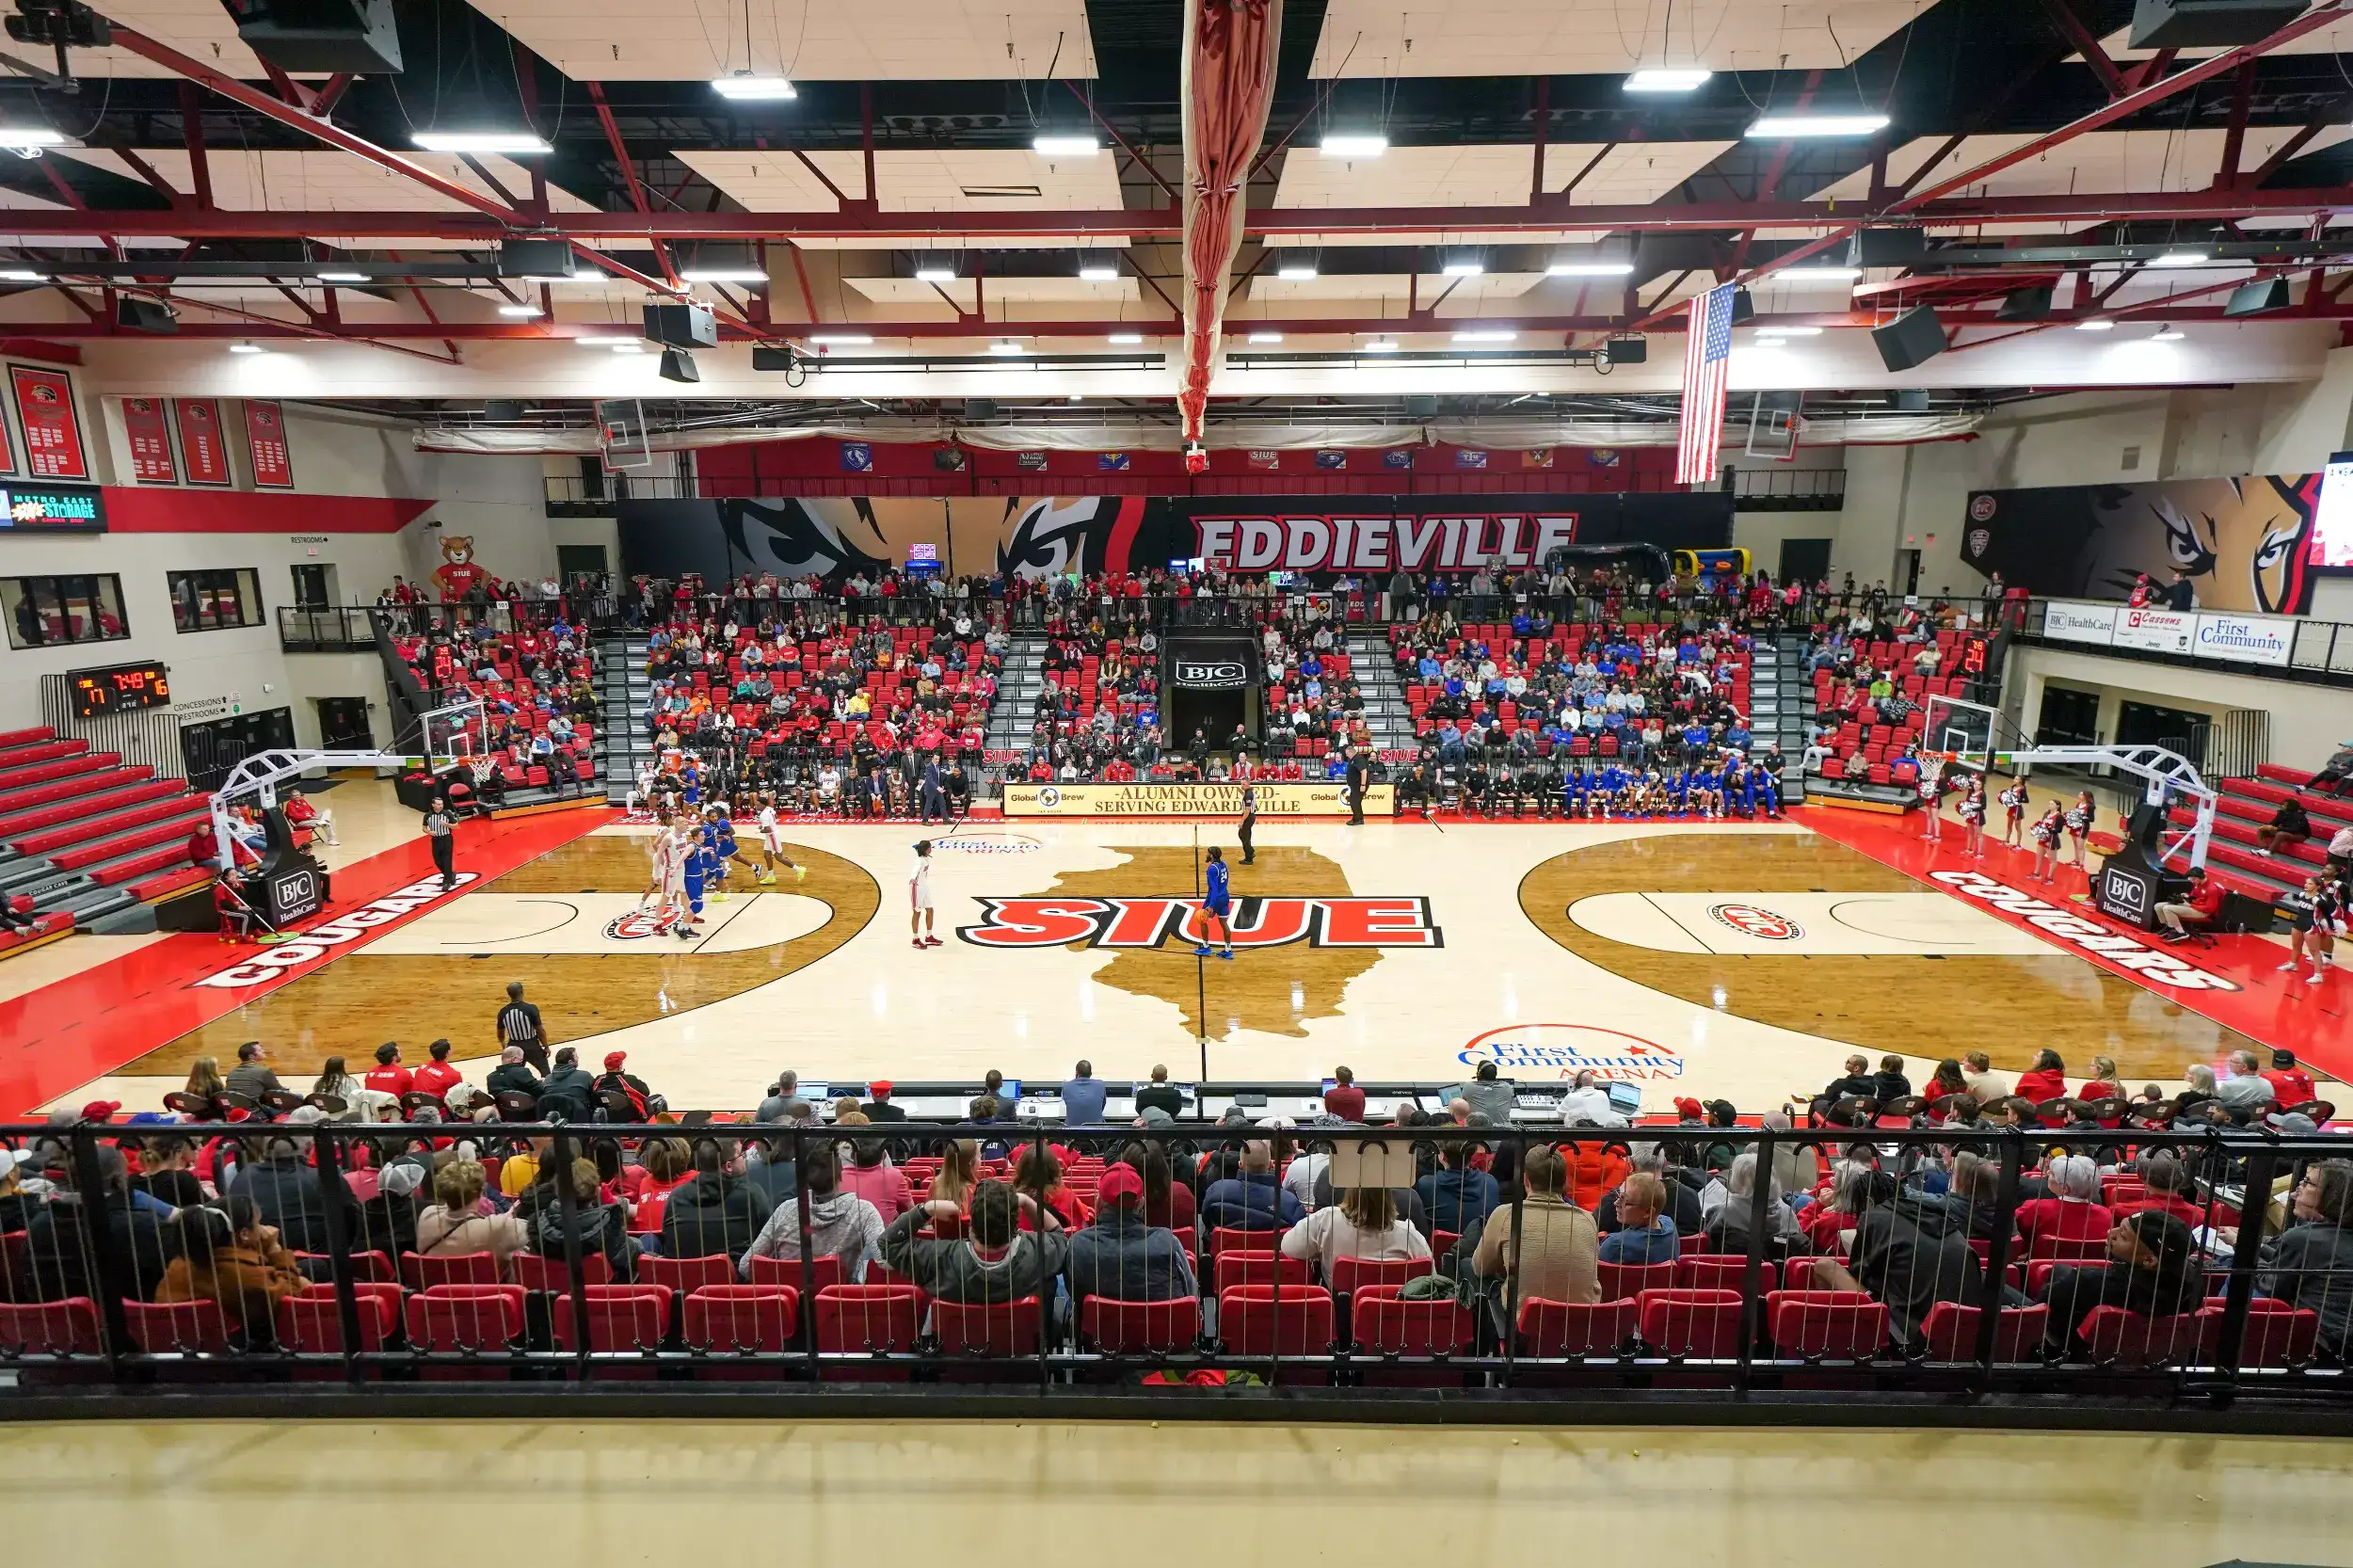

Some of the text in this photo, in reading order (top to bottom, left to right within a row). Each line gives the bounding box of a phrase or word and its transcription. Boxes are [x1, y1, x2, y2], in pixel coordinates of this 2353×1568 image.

[1251, 451, 1277, 459] SIUE
[14, 495, 56, 504] METRO
[44, 503, 96, 519] STORAGE
[1193, 516, 1577, 570] EDDIEVILLE
[2050, 615, 2112, 631] BJC HealthCare
[2141, 612, 2182, 626] Cassens
[2217, 619, 2249, 635] First
[2201, 627, 2285, 659] Community
[1965, 648, 1984, 671] 24
[112, 672, 144, 690] 7:49
[1185, 666, 1237, 680] BJC
[154, 680, 168, 696] 16
[173, 696, 222, 712] CONCESSIONS
[179, 708, 219, 721] RESTROOMS
[1379, 749, 1419, 763] SIUE
[1011, 793, 1037, 802] Global
[1311, 792, 1337, 801] Global
[1095, 800, 1300, 812] SERVING EDWARDVILLE
[280, 877, 310, 904] BJC
[2110, 875, 2141, 904] BJC
[280, 903, 316, 923] HealthCare
[2103, 902, 2142, 924] HealthCare
[2297, 900, 2314, 911] IUE
[190, 871, 481, 988] COUGARS
[958, 896, 1443, 948] SIUE
[1927, 870, 2244, 991] COUGARS
[1490, 1043, 1581, 1057] First
[1458, 1050, 1684, 1076] Community
[1559, 1068, 1675, 1080] ARENA
